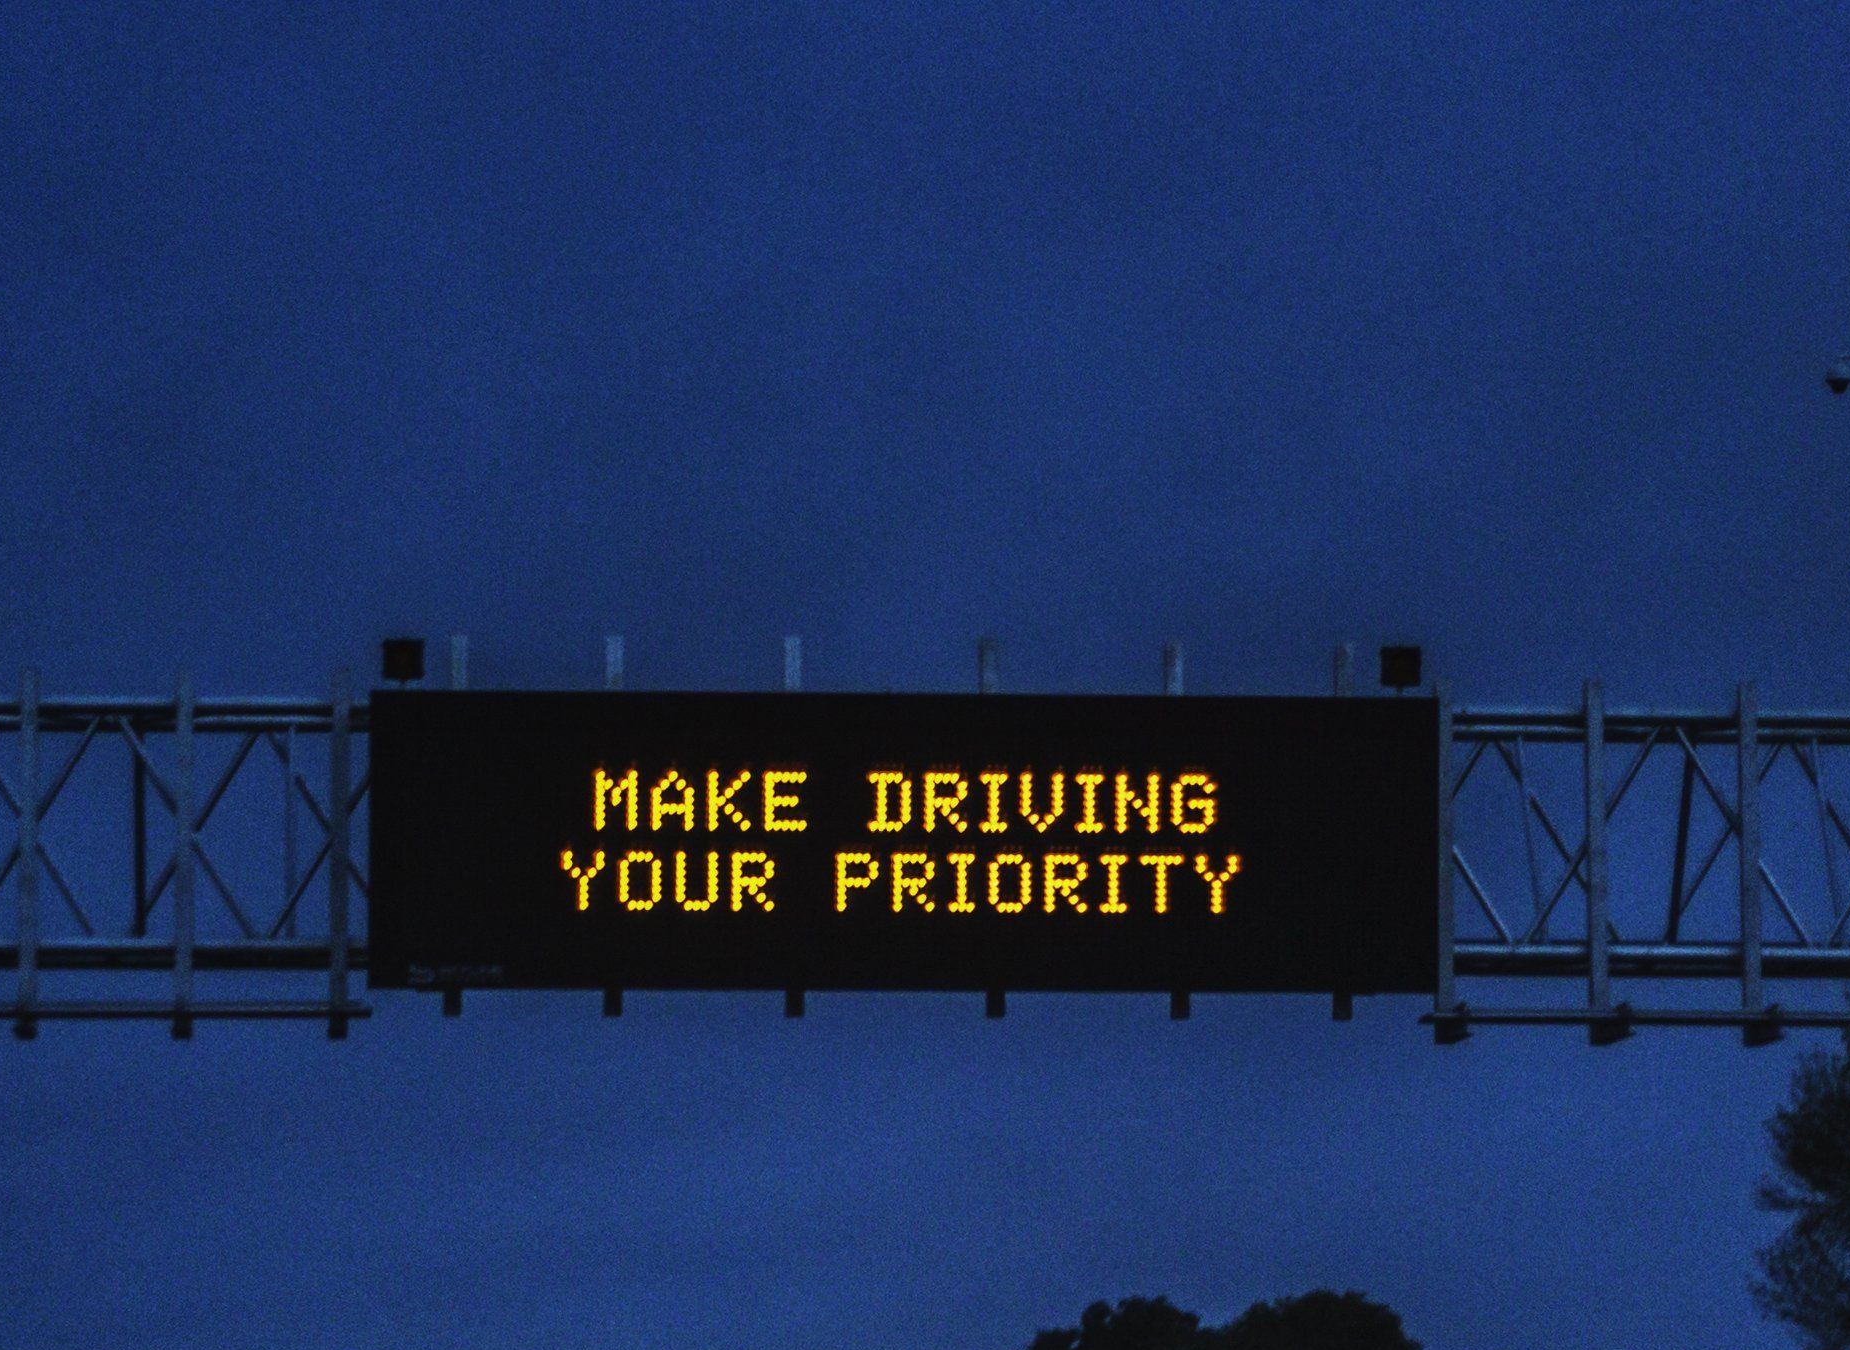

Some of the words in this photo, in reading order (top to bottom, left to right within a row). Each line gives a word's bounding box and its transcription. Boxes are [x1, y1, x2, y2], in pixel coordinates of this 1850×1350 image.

[591, 767, 809, 833] MAKE
[864, 770, 1218, 835] DRIVING
[558, 849, 777, 913] YOUR
[832, 850, 1242, 915] PRIORITY
